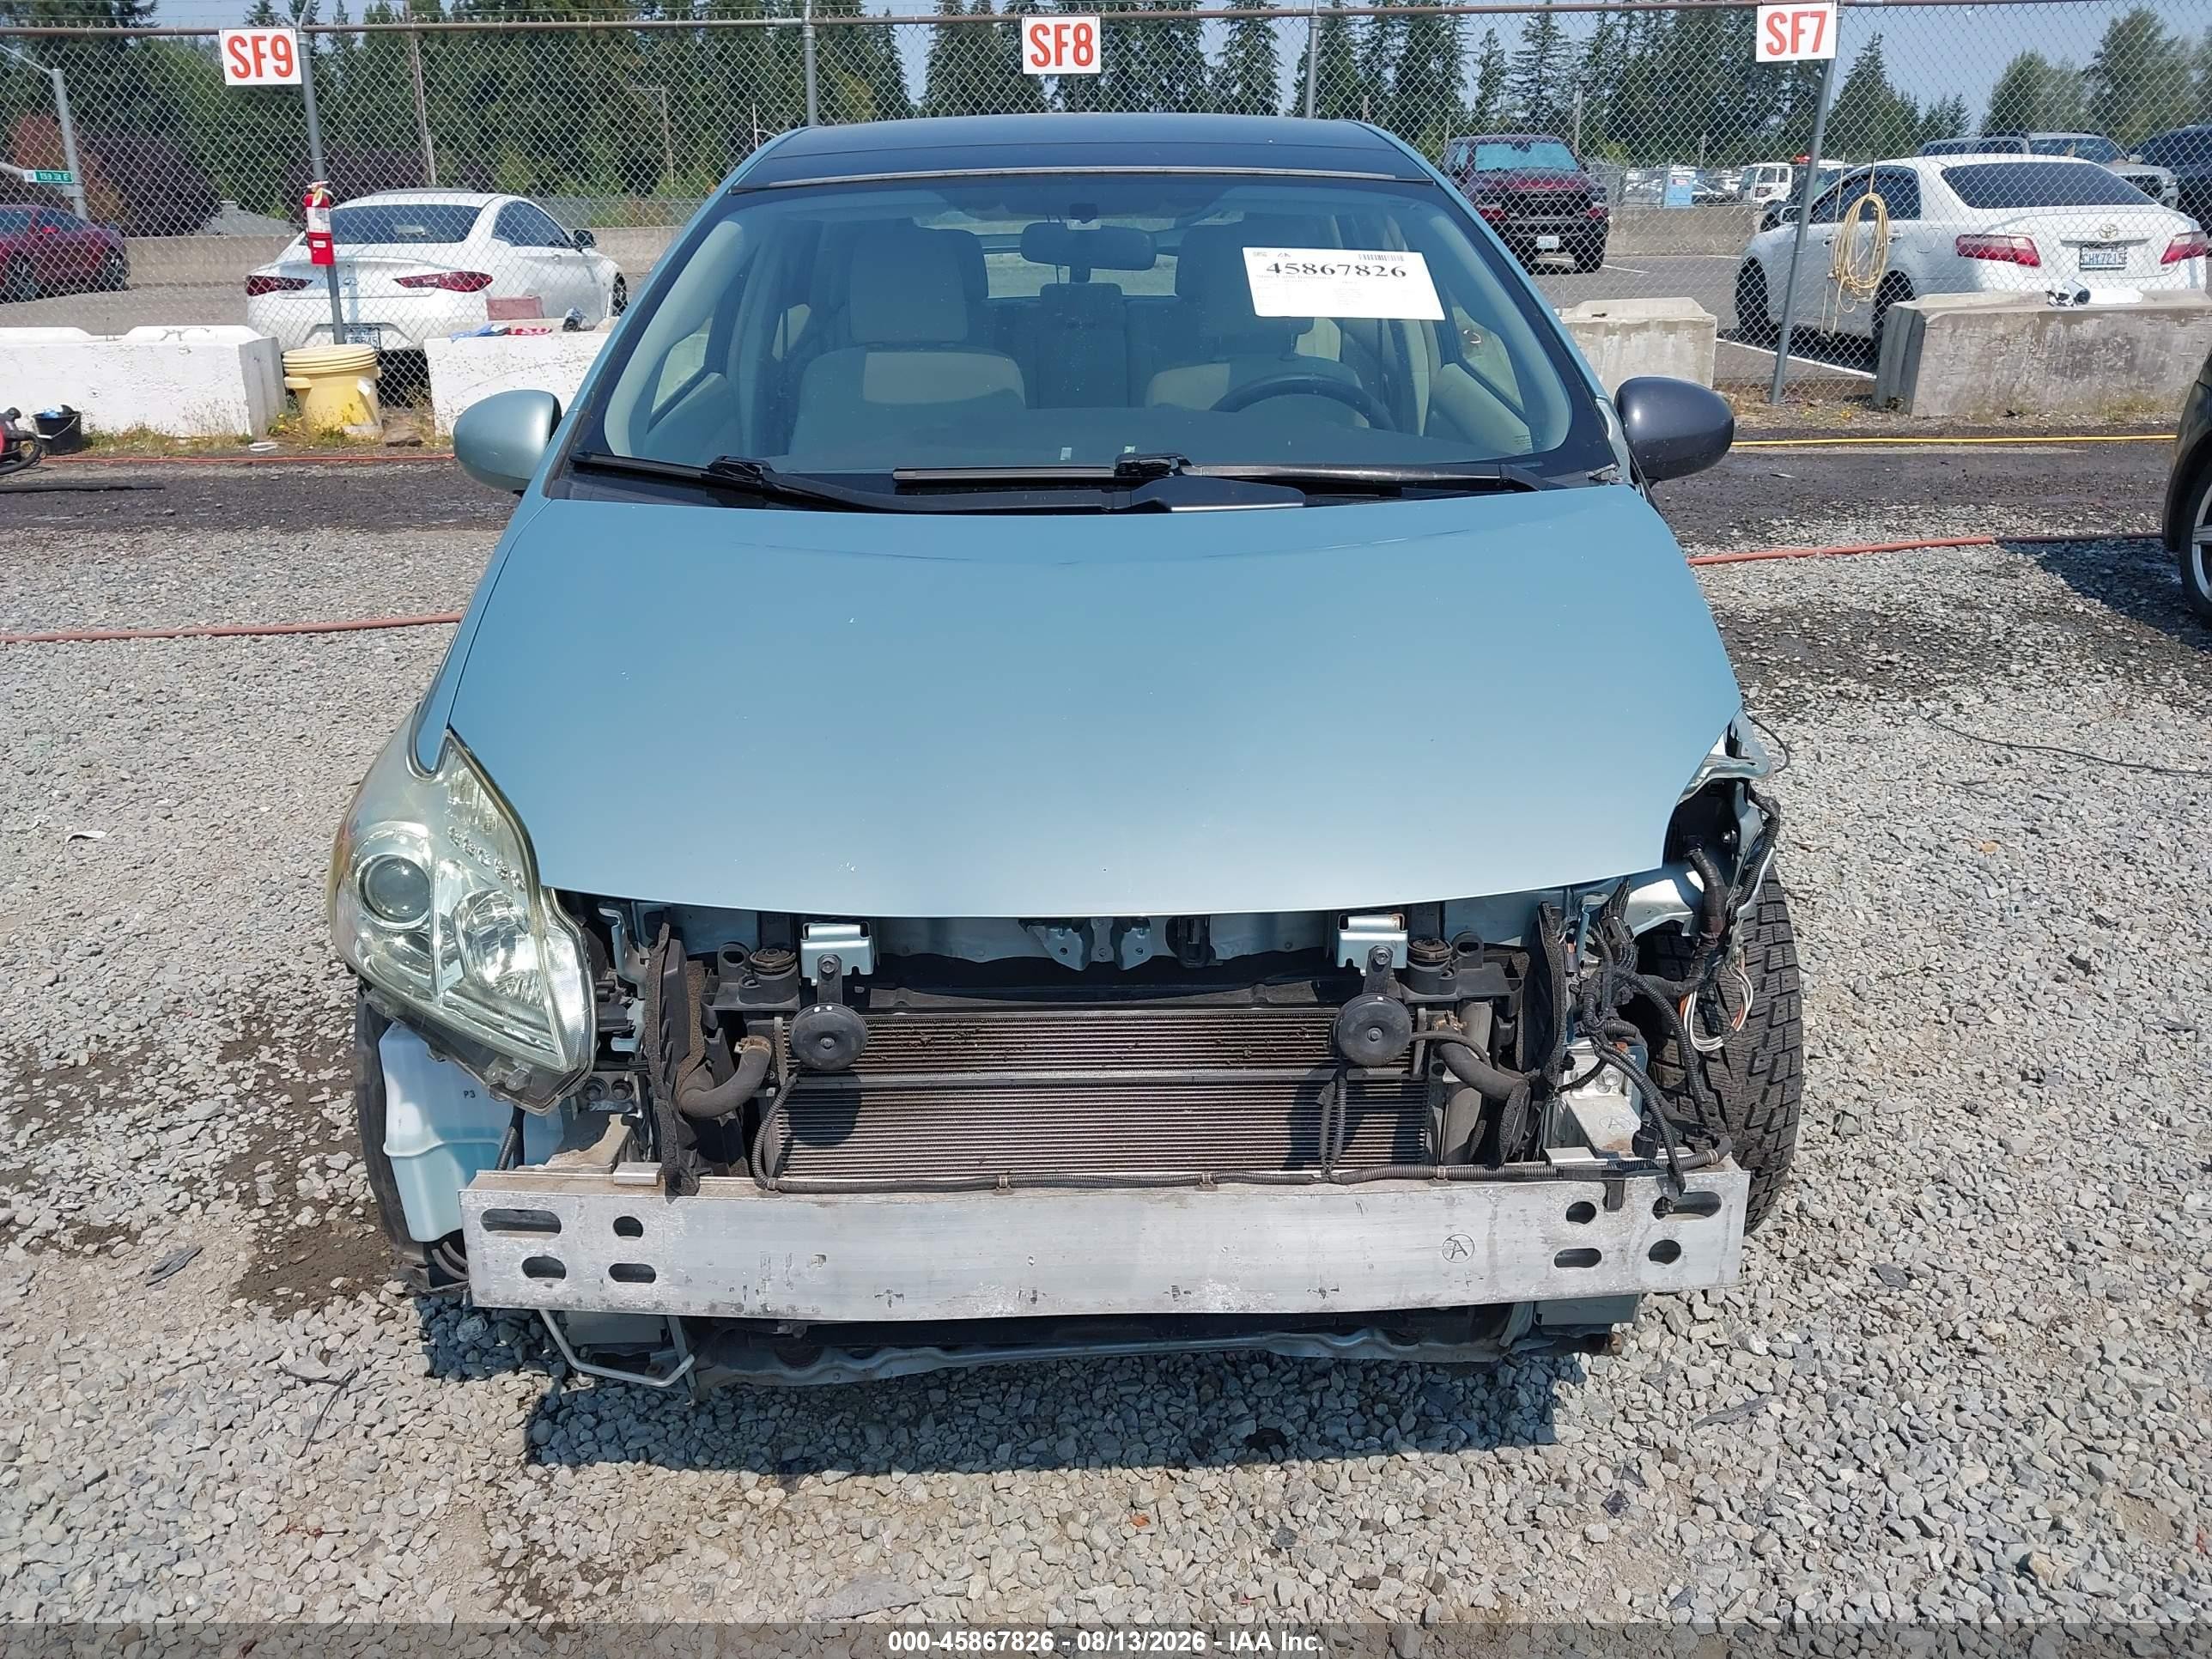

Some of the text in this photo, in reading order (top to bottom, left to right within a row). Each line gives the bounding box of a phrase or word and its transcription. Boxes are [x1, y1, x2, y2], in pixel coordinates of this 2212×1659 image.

[1030, 23, 1093, 67] SF8
[1765, 10, 1826, 55] SF7
[228, 35, 293, 78] SF9
[1266, 262, 1407, 277] 45867826
[464, 1090, 476, 1099] P3
